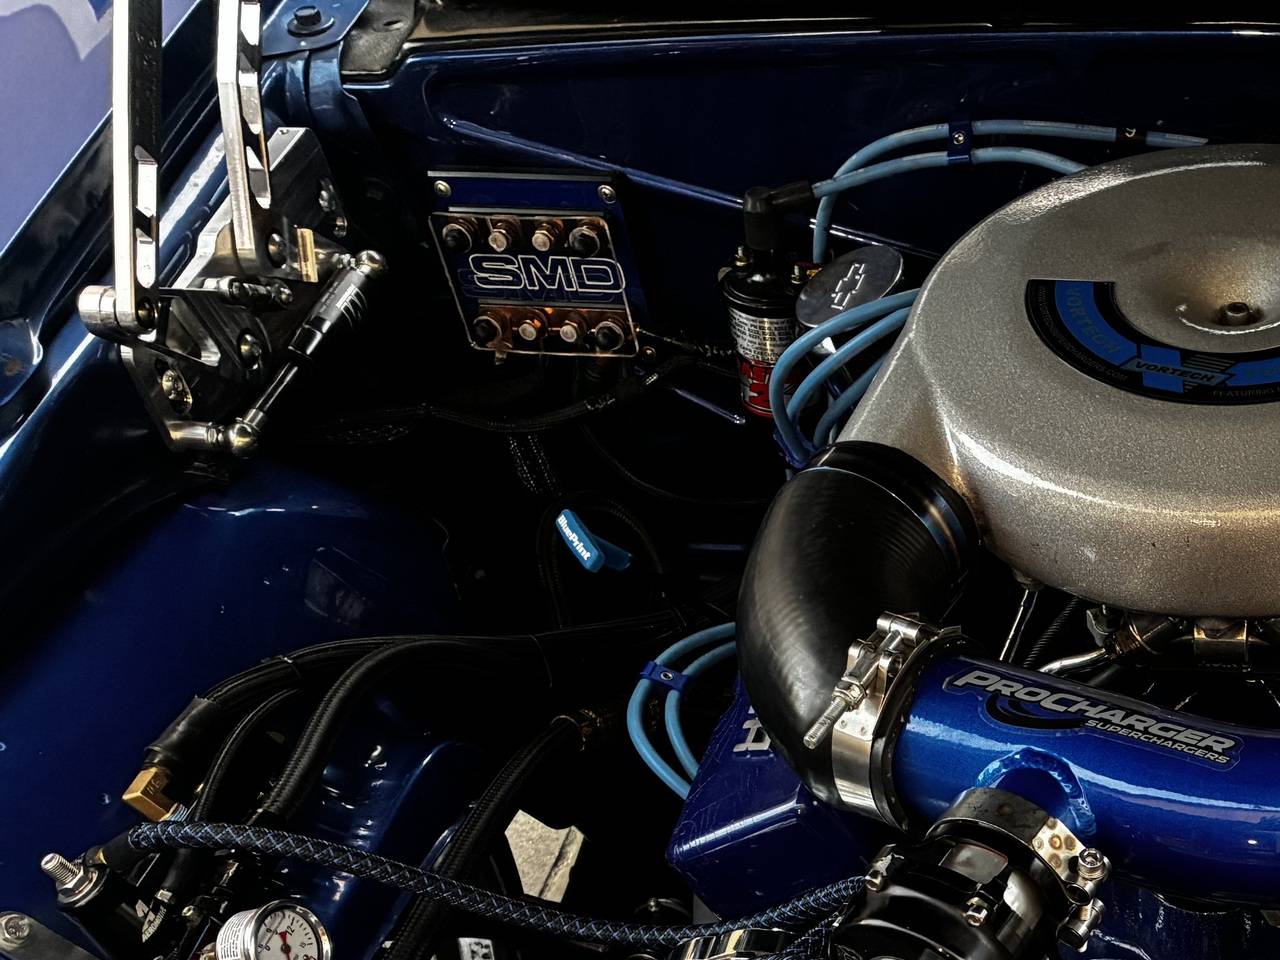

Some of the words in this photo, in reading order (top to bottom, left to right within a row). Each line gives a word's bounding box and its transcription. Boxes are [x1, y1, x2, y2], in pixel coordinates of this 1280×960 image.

[468, 253, 627, 293] SMD
[1136, 360, 1216, 383] VORTECH
[557, 513, 593, 562] BluePrint
[952, 669, 1236, 753] PROCHARGER
[1084, 718, 1231, 765] SUPERCHARGERS
